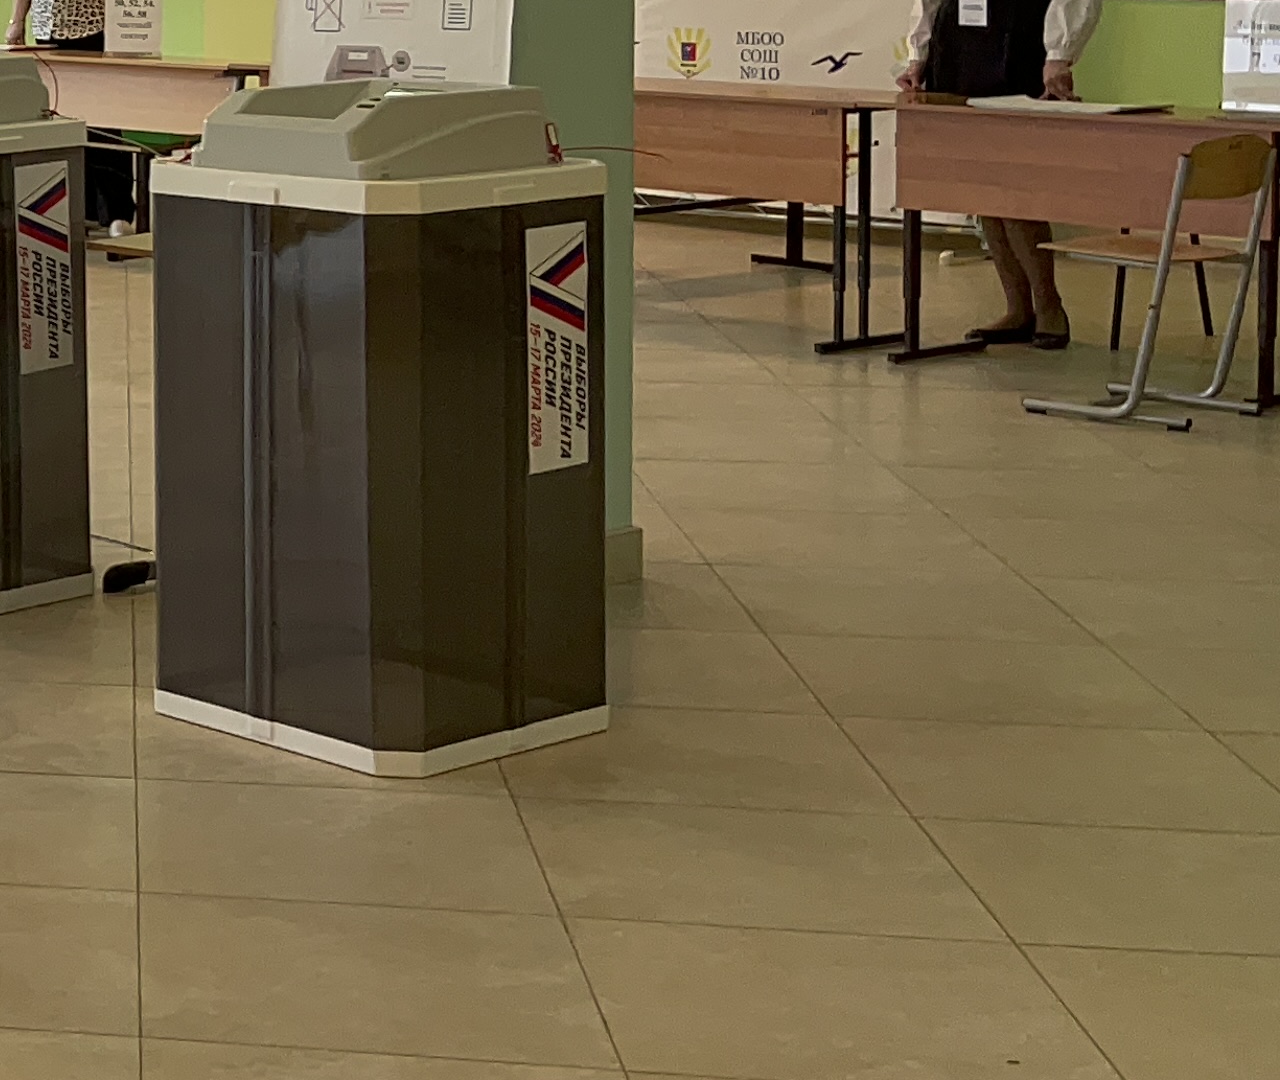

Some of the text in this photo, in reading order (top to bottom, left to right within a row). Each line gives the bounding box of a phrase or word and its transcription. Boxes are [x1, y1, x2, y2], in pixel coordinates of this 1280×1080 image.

[736, 31, 785, 46] МБОО
[740, 48, 779, 64] СОШ
[739, 66, 780, 81] №10
[20, 278, 31, 320] МАРТА
[32, 250, 44, 317] РОССИИ
[46, 255, 60, 360] ПРЕЗИДЕНТА
[60, 263, 72, 335] ВЫБОРЫ
[531, 364, 542, 411] МАРТА
[544, 328, 557, 408] РОССИИ
[575, 343, 587, 431] ВЫБОРЫ
[560, 335, 572, 459] ПРЕЗИДЕНТА
[531, 412, 543, 447] 2024
